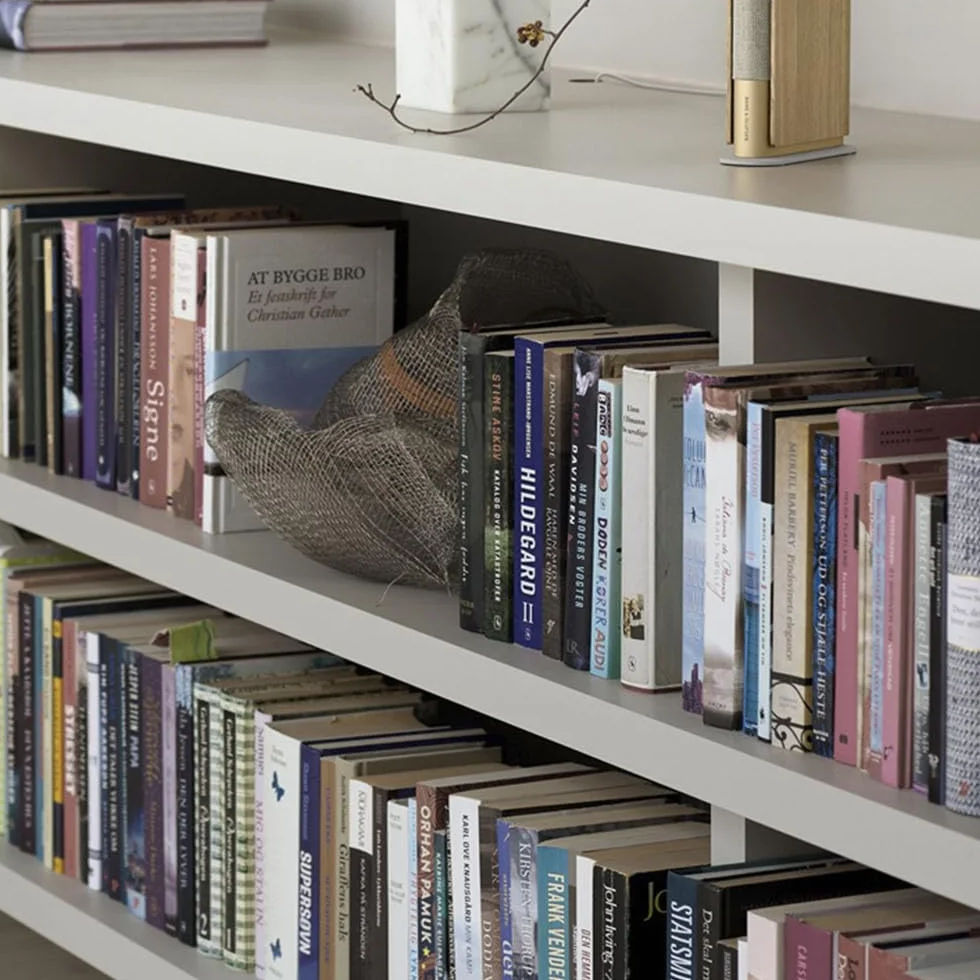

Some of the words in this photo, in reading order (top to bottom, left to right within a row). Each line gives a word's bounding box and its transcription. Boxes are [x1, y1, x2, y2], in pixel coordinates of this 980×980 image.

[149, 247, 158, 280] LARS
[247, 271, 269, 286] AT
[273, 268, 329, 284] BYGGE
[333, 266, 366, 282] BRO
[247, 306, 305, 323] Christian
[309, 305, 351, 320] Gether
[264, 287, 318, 308] festskrift
[149, 286, 158, 370] JOHANSSON
[492, 373, 502, 412] STINE
[548, 374, 556, 437] EDMUND
[144, 379, 166, 462] Signe
[492, 418, 502, 461] ASKOV
[548, 441, 556, 458] DE
[787, 442, 798, 490] MURIEL
[820, 449, 828, 472] PER
[548, 464, 556, 500] WAAL
[569, 444, 578, 525] DAVIDSEN
[578, 483, 587, 504] MIN
[520, 467, 536, 596] HILDEGARD
[787, 493, 798, 548] BARBERY
[820, 476, 828, 548] PETTERSON
[597, 517, 608, 570] DØDEN
[918, 502, 930, 584] Annette
[494, 539, 502, 602] KATASTROFER
[575, 566, 585, 608] VOGTER
[786, 554, 796, 614] Pindsvinets
[818, 554, 828, 578] UD
[596, 576, 608, 626] KØRER
[818, 584, 828, 607] OG
[784, 616, 795, 661] elegance
[815, 612, 826, 666] STJÆLE
[916, 593, 929, 658] Engell
[594, 628, 606, 672] AUDI
[129, 664, 139, 700] JESPER
[816, 671, 826, 720] HESTE
[129, 736, 139, 768] PAPA
[180, 778, 188, 808] DEN
[180, 812, 188, 840] DER
[420, 805, 432, 873] ORHAN
[462, 815, 470, 838] KARL
[462, 842, 470, 860] OVE
[338, 844, 350, 908] Giraffens
[464, 863, 473, 923] KNAUSGÅRD
[520, 843, 532, 907] KIRSTEN
[300, 850, 312, 956] SUPERSØVN
[420, 879, 432, 944] PAMUK
[548, 872, 566, 924] FRANK
[603, 884, 618, 923] John
[339, 912, 350, 942] hals
[581, 928, 592, 948] DEN
[702, 909, 713, 934] Det
[520, 915, 533, 976] THORUP
[702, 938, 713, 964] skal
